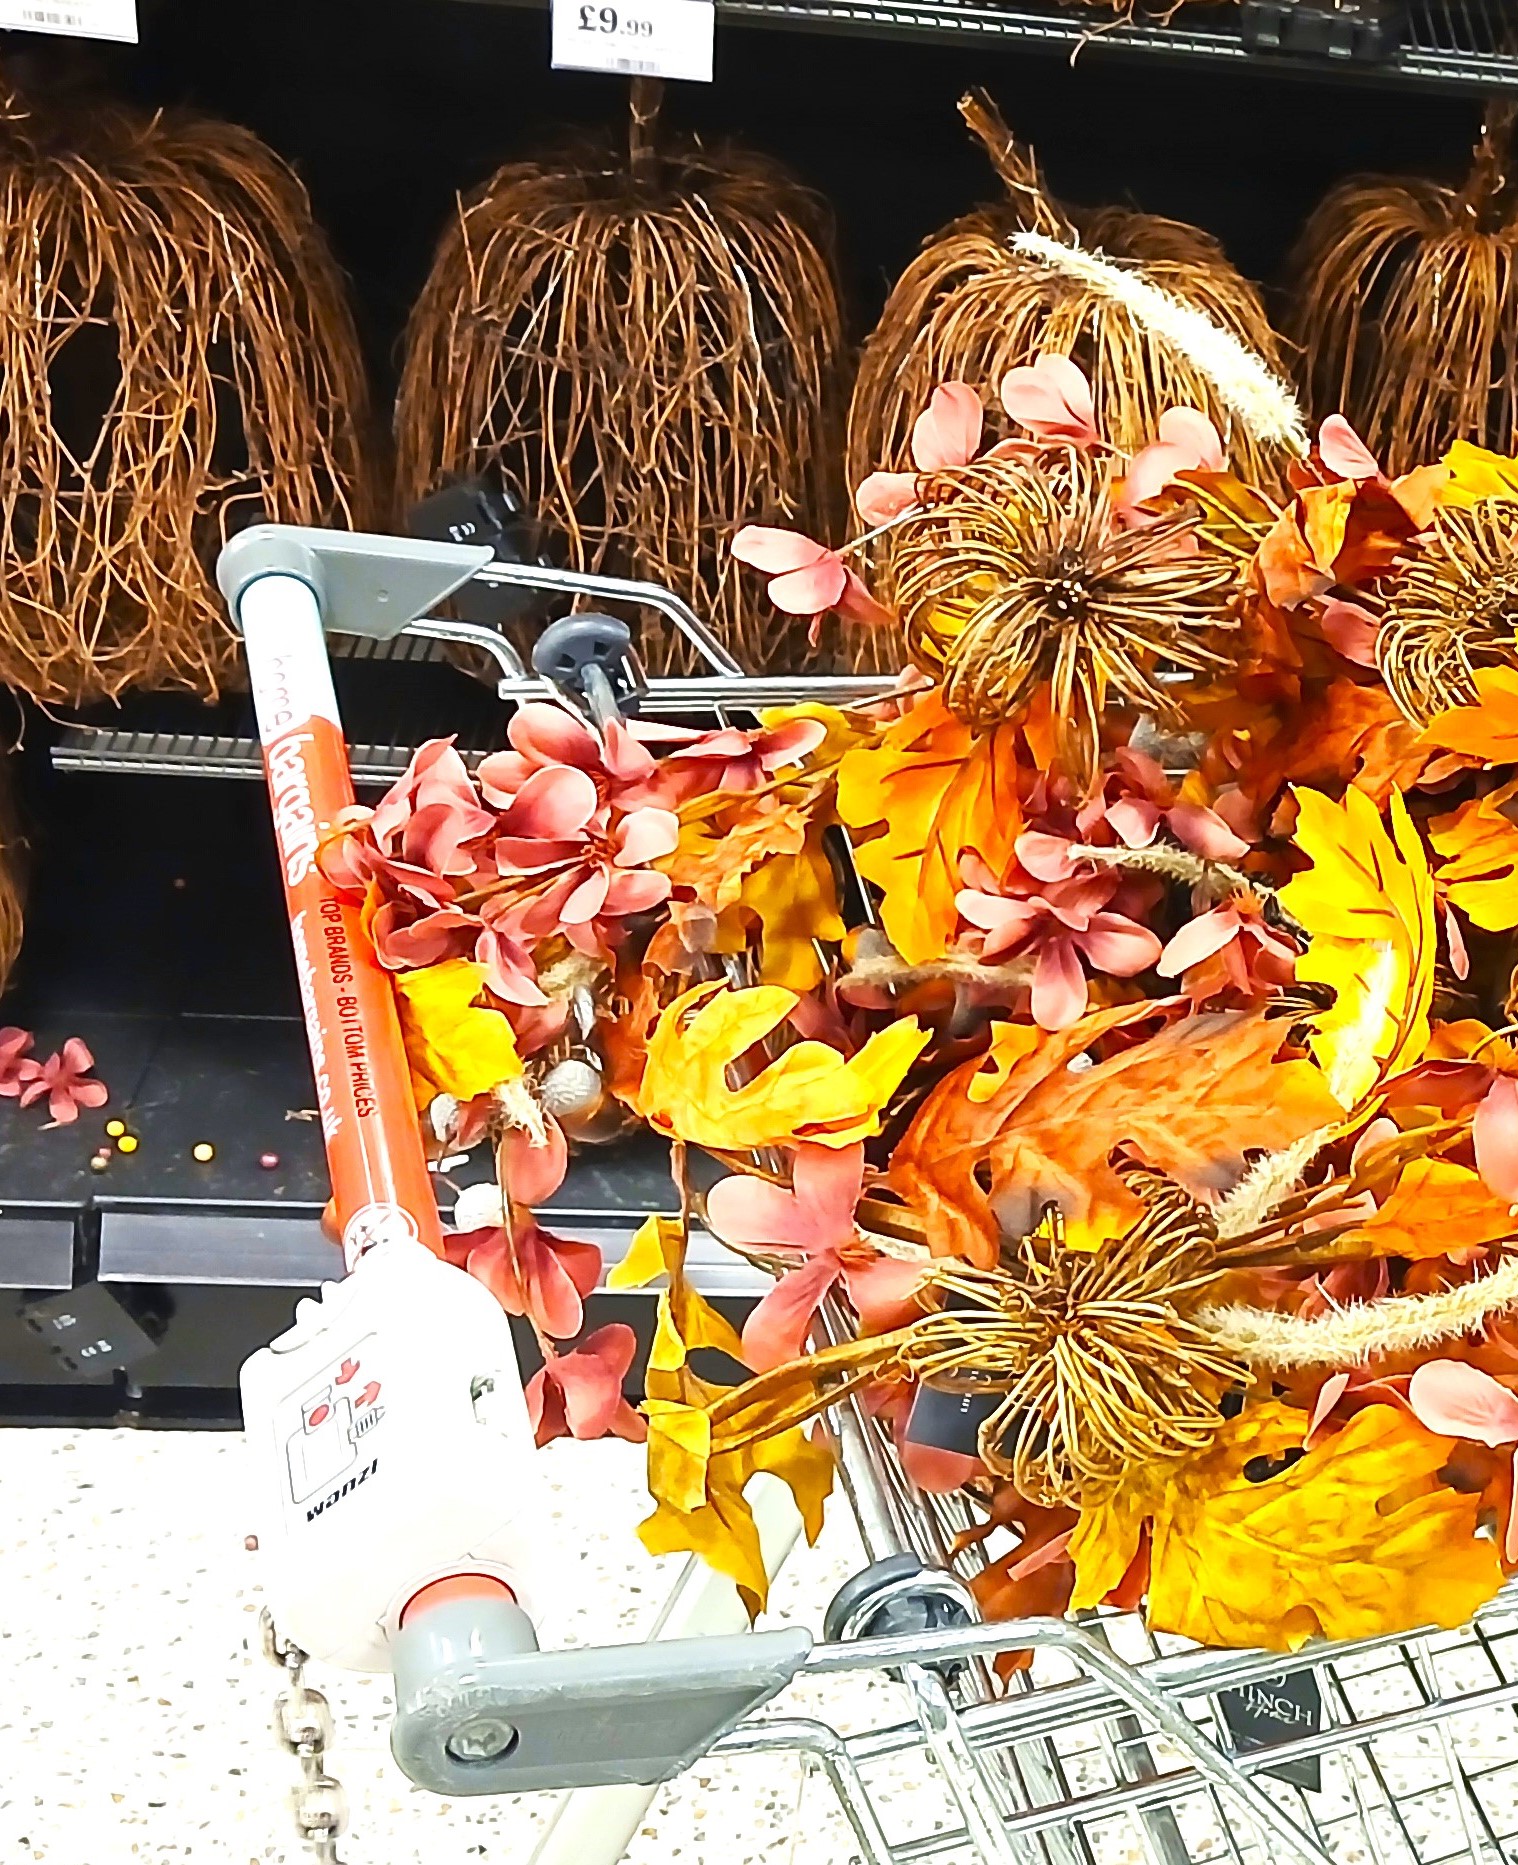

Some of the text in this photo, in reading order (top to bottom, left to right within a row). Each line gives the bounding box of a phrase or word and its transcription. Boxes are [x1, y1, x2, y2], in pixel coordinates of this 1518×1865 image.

[577, 4, 654, 38] £9.99
[268, 733, 331, 888] bargains
[319, 895, 341, 923] TOP
[323, 925, 354, 985] BRANDS
[336, 995, 367, 1060] BOTTOM
[349, 1061, 378, 1119] PRICES
[1238, 1684, 1313, 1727] INCH
